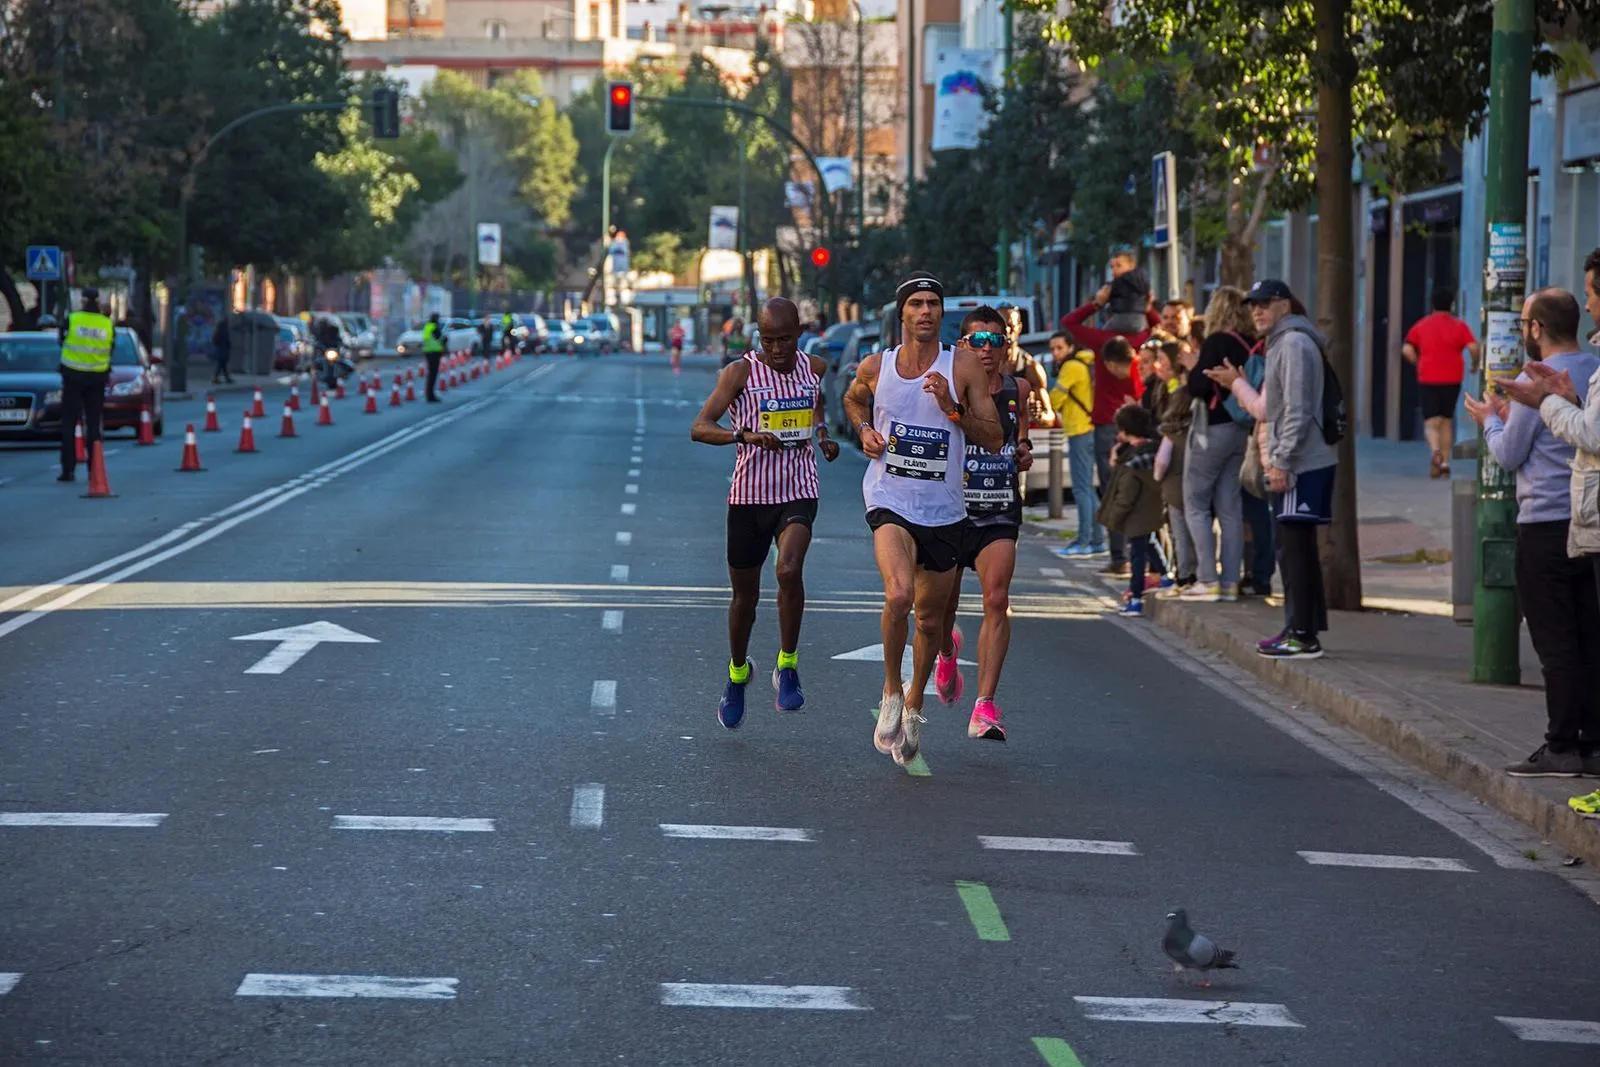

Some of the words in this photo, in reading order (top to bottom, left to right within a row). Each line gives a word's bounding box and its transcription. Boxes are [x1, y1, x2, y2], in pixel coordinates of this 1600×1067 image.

[780, 400, 809, 409] ZURICH
[782, 418, 798, 428] 671
[908, 428, 943, 439] ZURICH
[911, 444, 925, 455] 59
[980, 462, 1009, 470] ZURICH
[983, 477, 995, 487] 60
